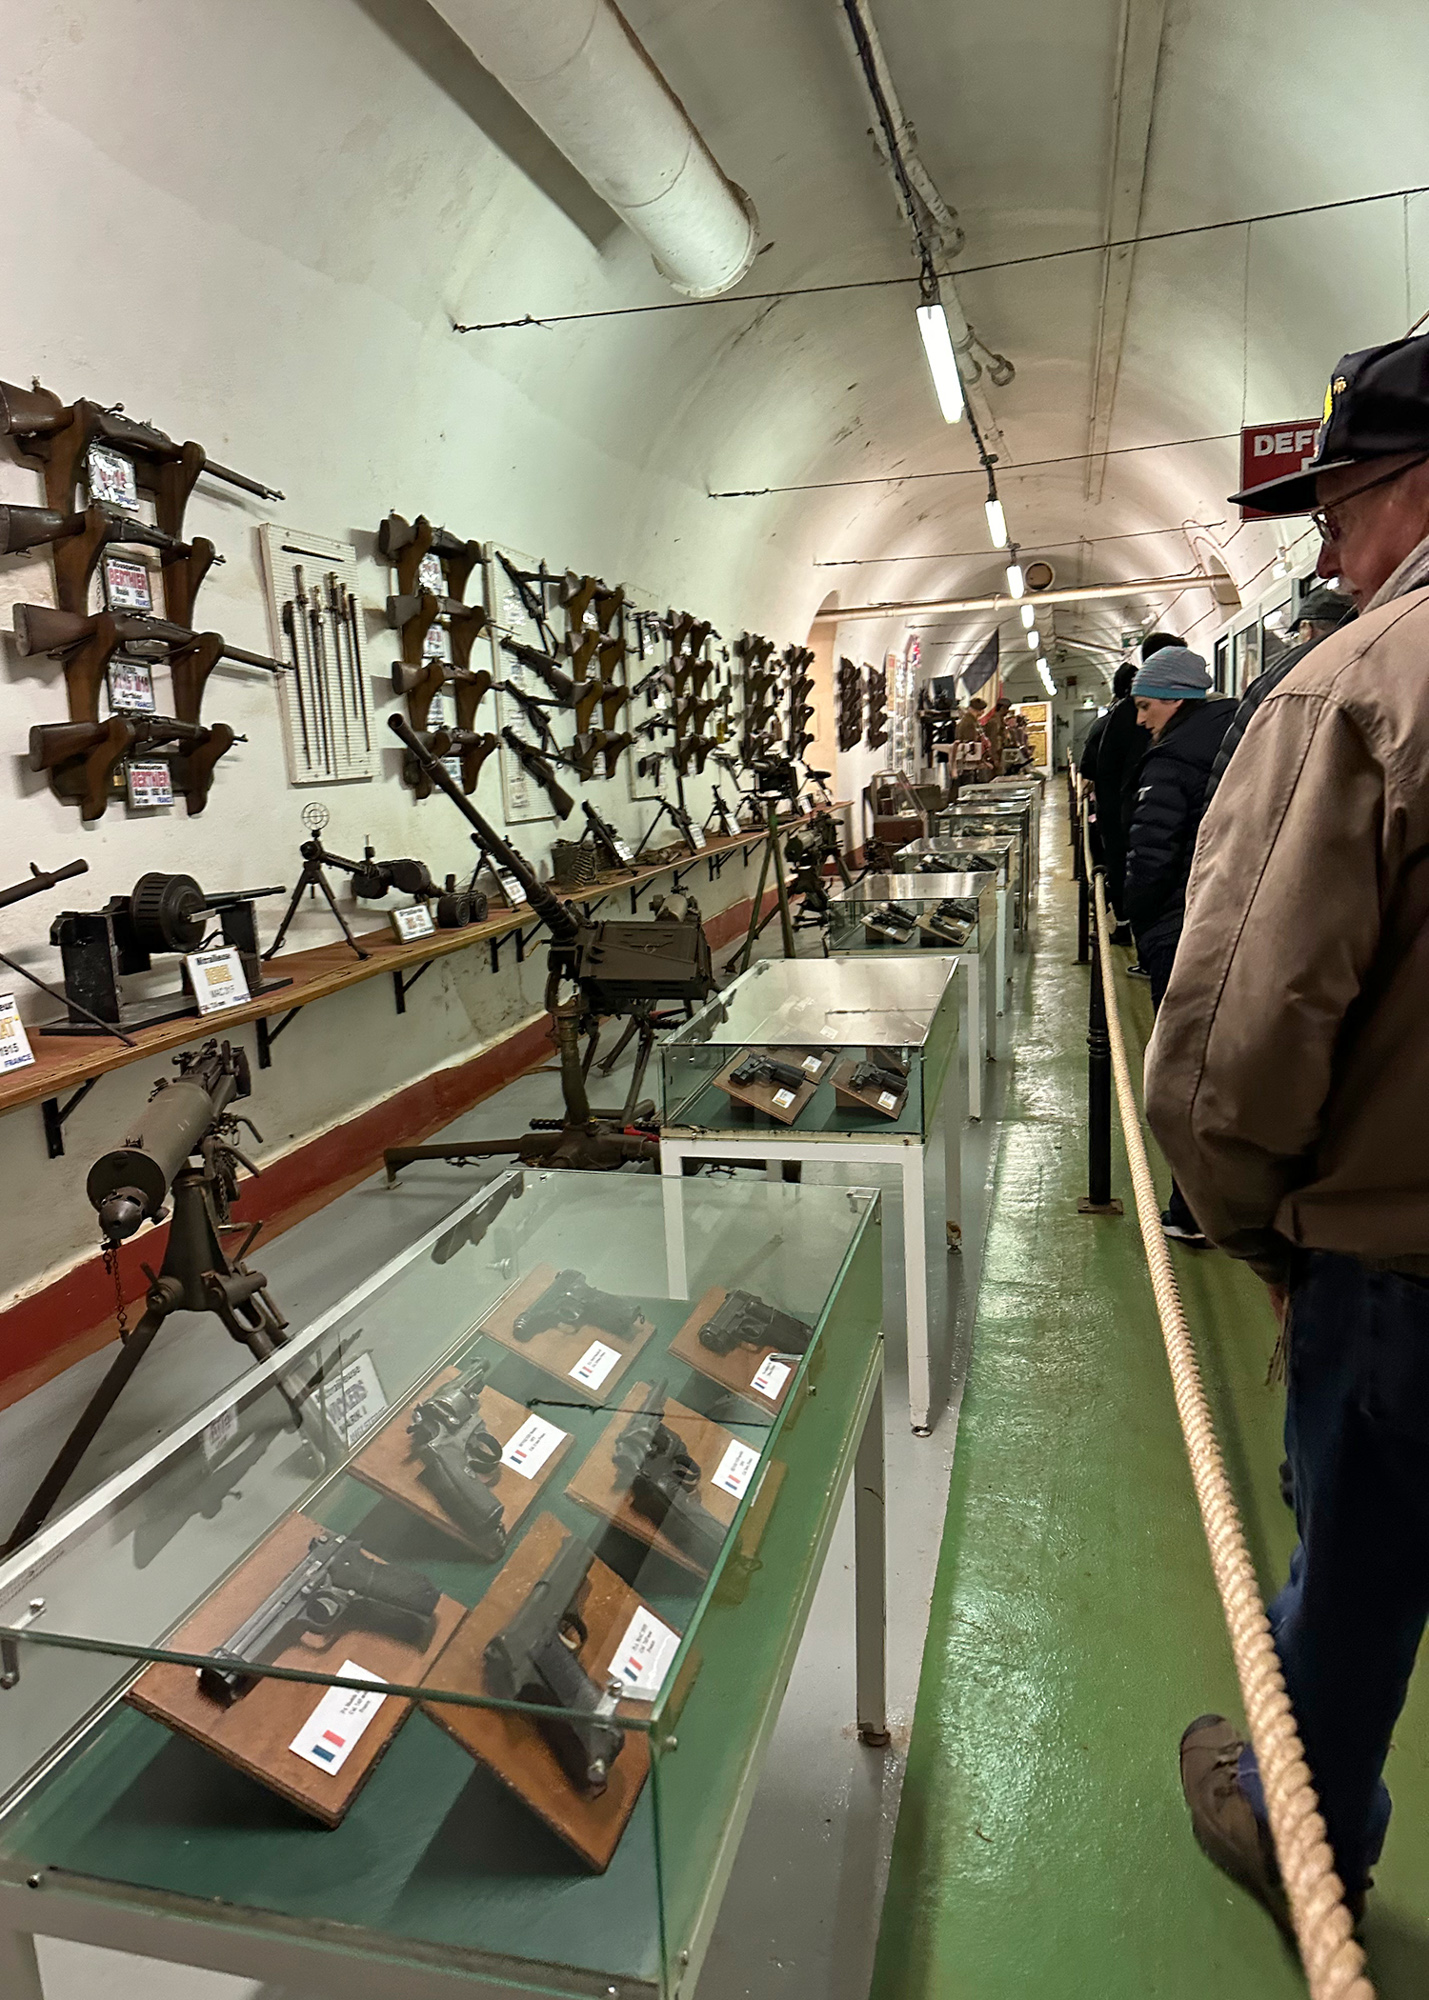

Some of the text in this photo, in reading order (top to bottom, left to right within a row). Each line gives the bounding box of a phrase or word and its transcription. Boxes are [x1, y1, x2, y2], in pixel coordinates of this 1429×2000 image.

[109, 567, 147, 590] BERTHIER
[131, 771, 169, 788] BERTHIER
[4, 1052, 33, 1067] FRANCE
